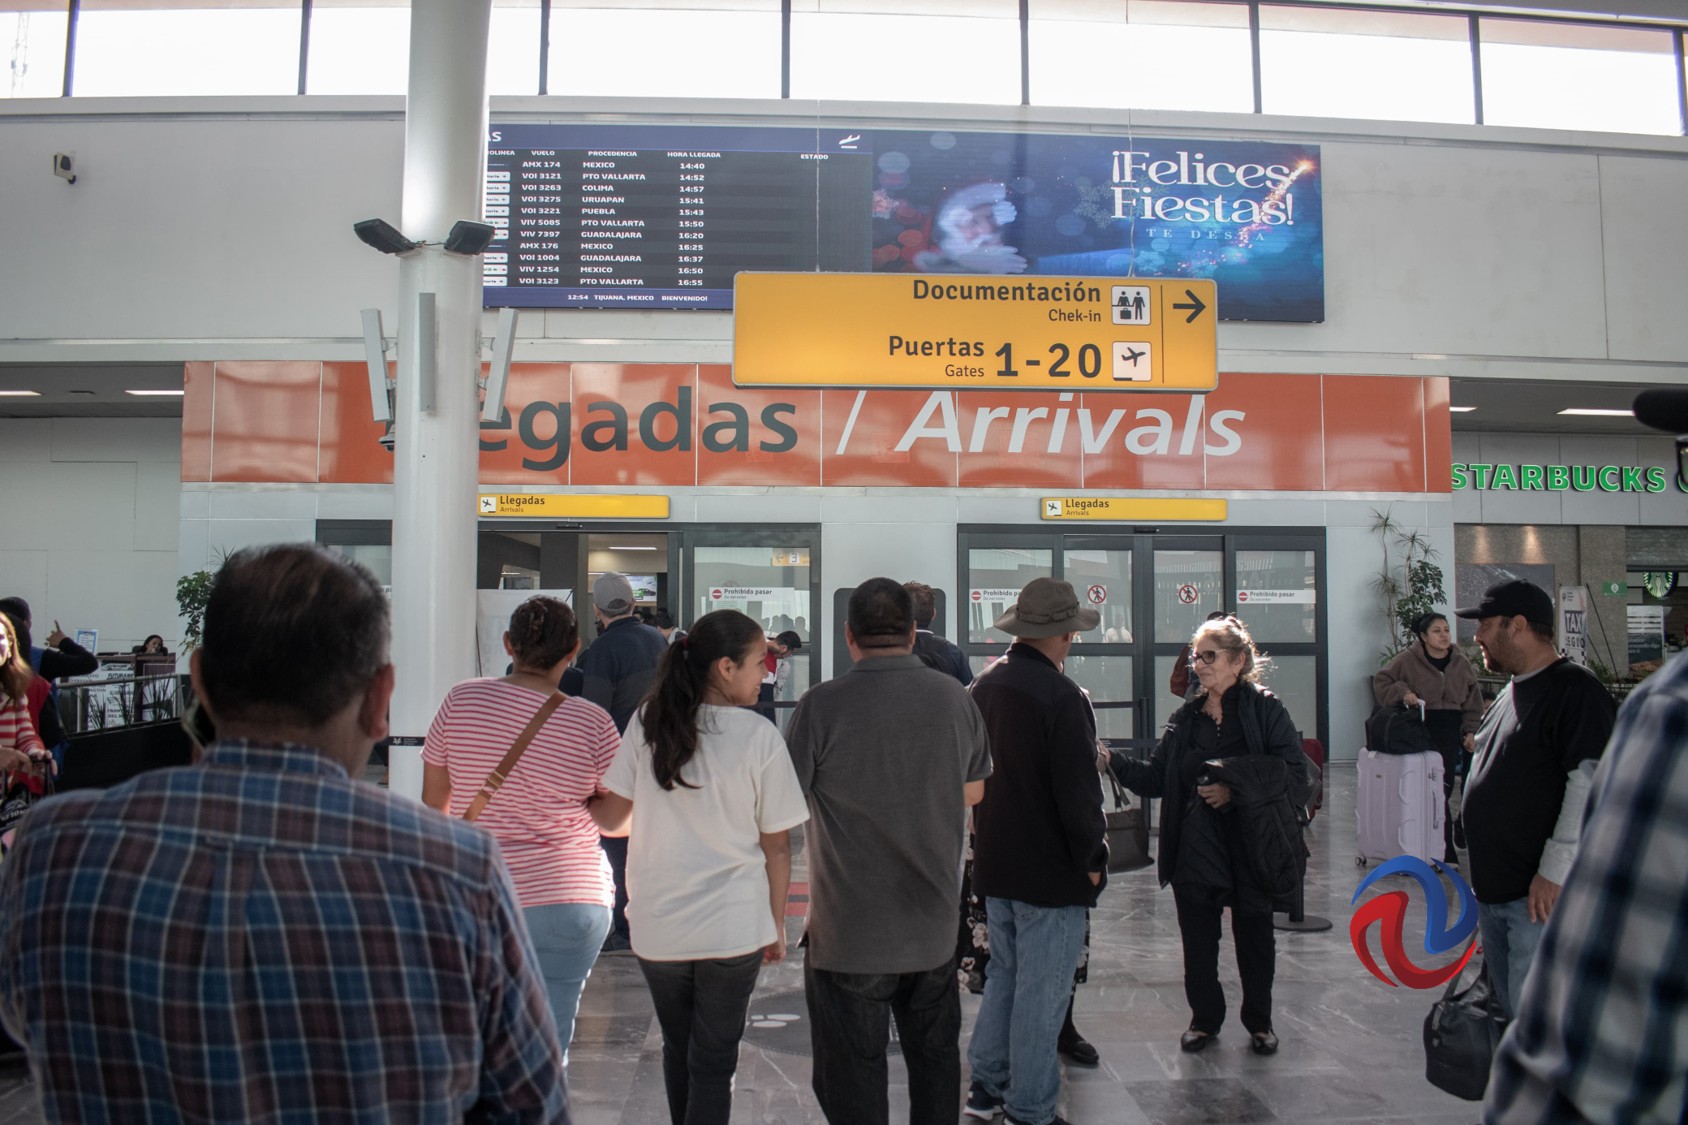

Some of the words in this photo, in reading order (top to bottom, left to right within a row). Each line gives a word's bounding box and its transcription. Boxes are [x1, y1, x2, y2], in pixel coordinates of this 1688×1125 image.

[1111, 150, 1292, 189] ¡Felices
[1110, 186, 1294, 226] Fiestas!
[1146, 228, 1172, 238] TE
[913, 279, 1101, 302] Documentación
[1048, 309, 1101, 322] Chek-in
[888, 336, 985, 357] Puertas
[995, 342, 1102, 378] 1-20
[945, 364, 984, 378] Gates
[479, 386, 798, 471] egadas
[894, 391, 1246, 456] Arrivals
[1451, 463, 1666, 492] STARBUCKS
[500, 496, 546, 507] Llegadas
[1066, 499, 1110, 510] Llegadas
